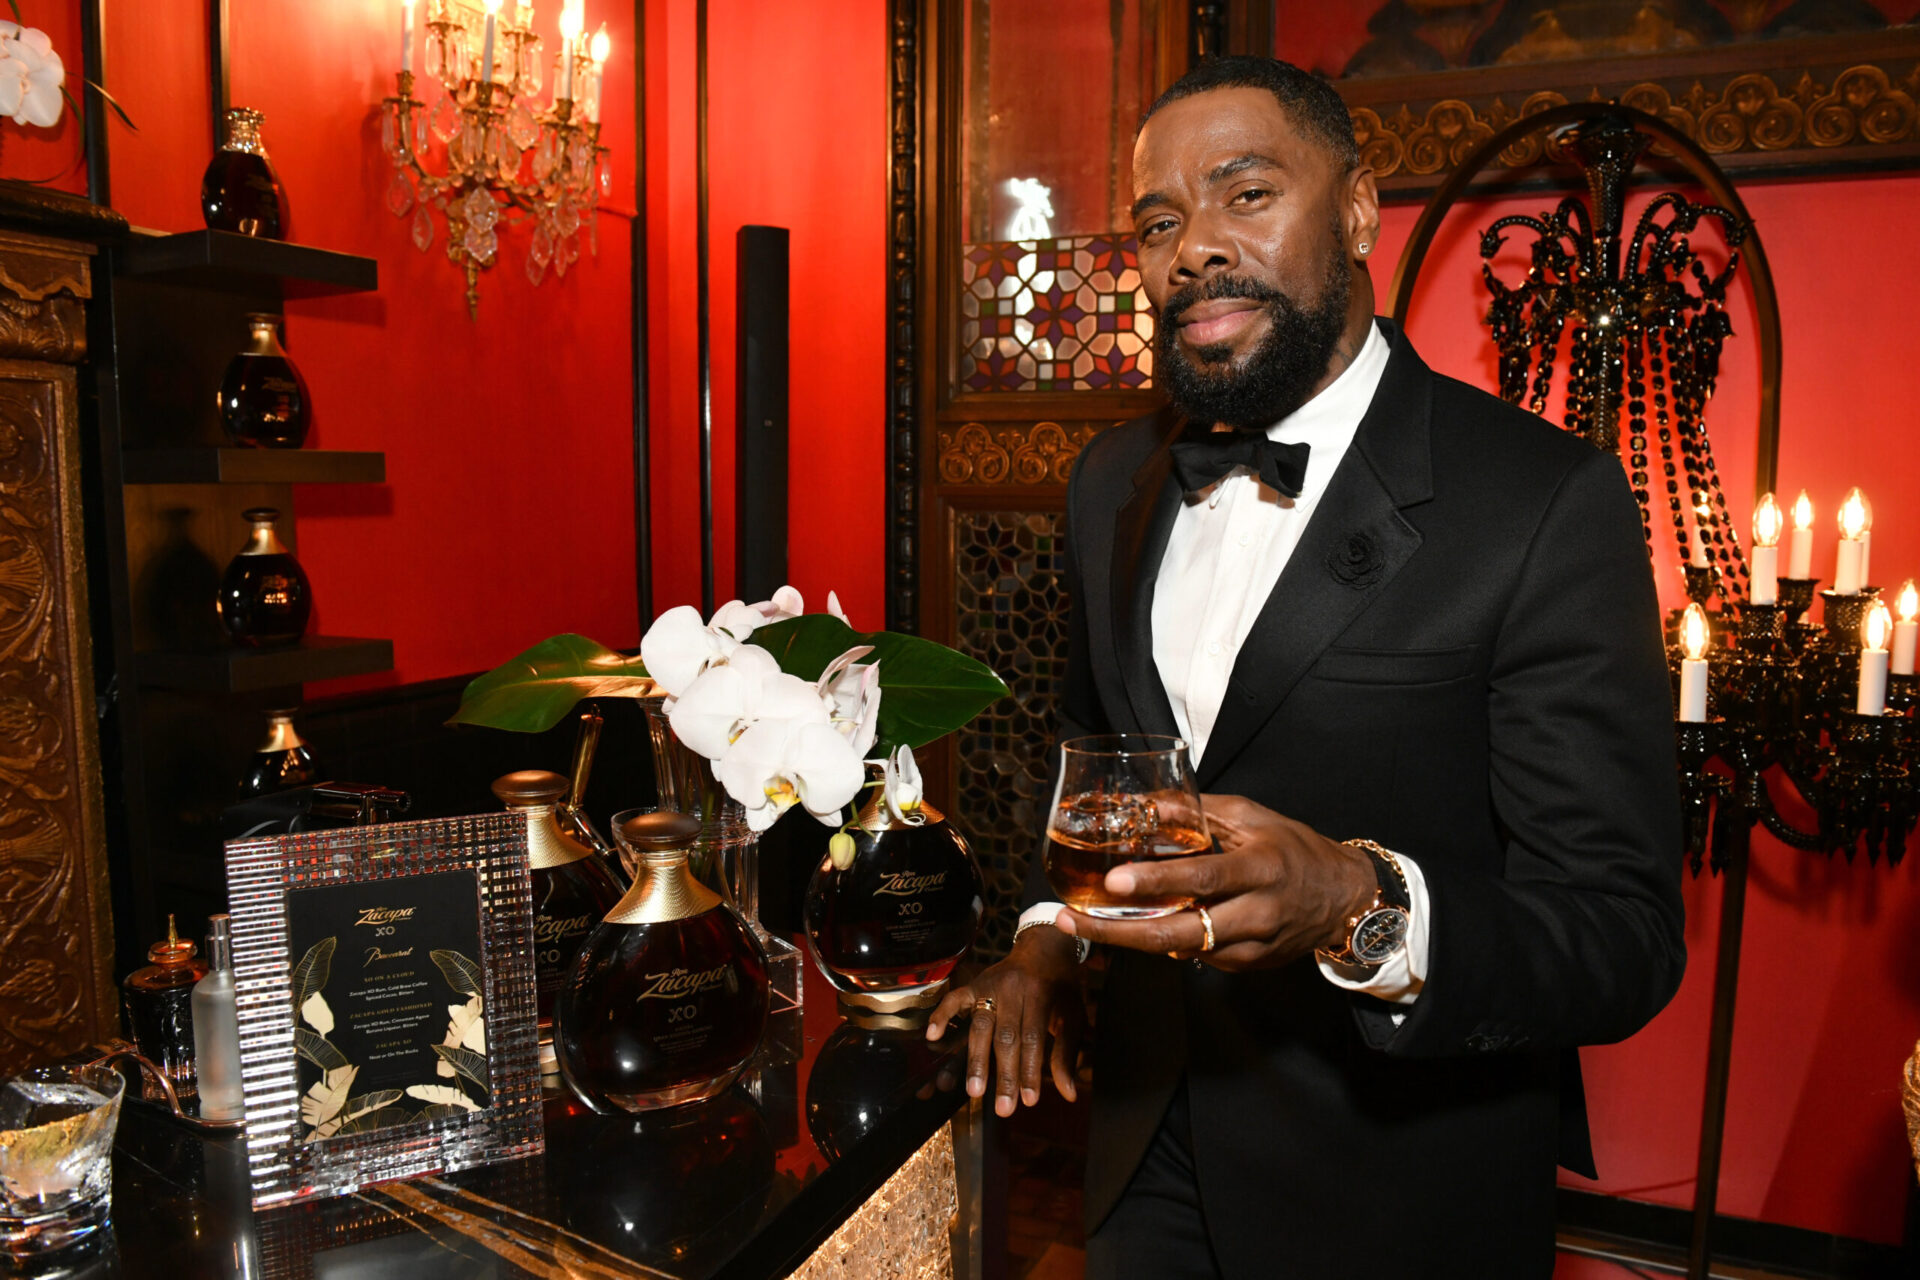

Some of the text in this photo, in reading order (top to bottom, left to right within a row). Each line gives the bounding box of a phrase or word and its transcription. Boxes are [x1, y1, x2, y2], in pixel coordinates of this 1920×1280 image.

[873, 871, 948, 897] Zacapa
[354, 906, 416, 926] Zacapa
[898, 902, 923, 916] XO
[375, 925, 395, 937] XO
[533, 913, 592, 944] capa
[363, 946, 413, 968] Baccarat
[636, 964, 727, 1003] Zacapa
[668, 1004, 697, 1023] XO
